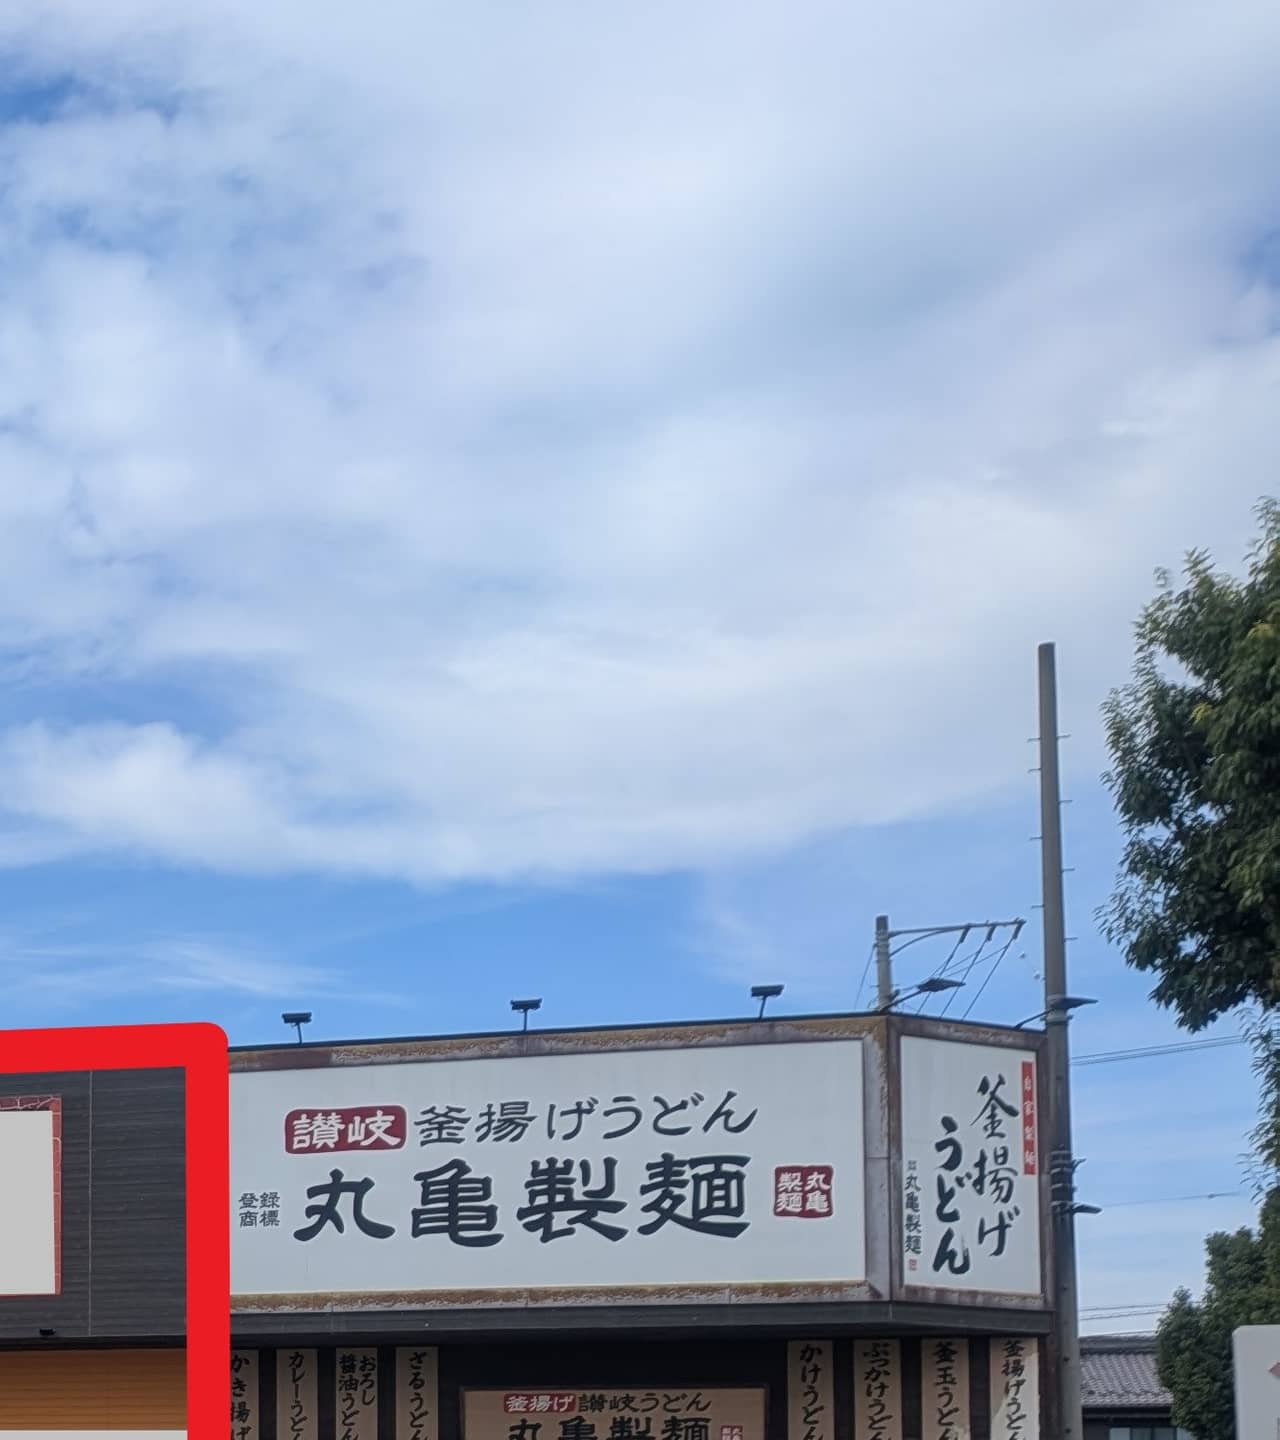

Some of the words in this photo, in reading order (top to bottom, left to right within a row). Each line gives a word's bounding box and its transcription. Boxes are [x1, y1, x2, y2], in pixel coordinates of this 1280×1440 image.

[413, 1090, 758, 1147] 釜揚げうどん
[970, 1073, 1020, 1257] 釜揚げ
[293, 1152, 752, 1248] 丸亀製麺
[932, 1115, 973, 1275] うどん
[359, 1355, 377, 1406] おろし
